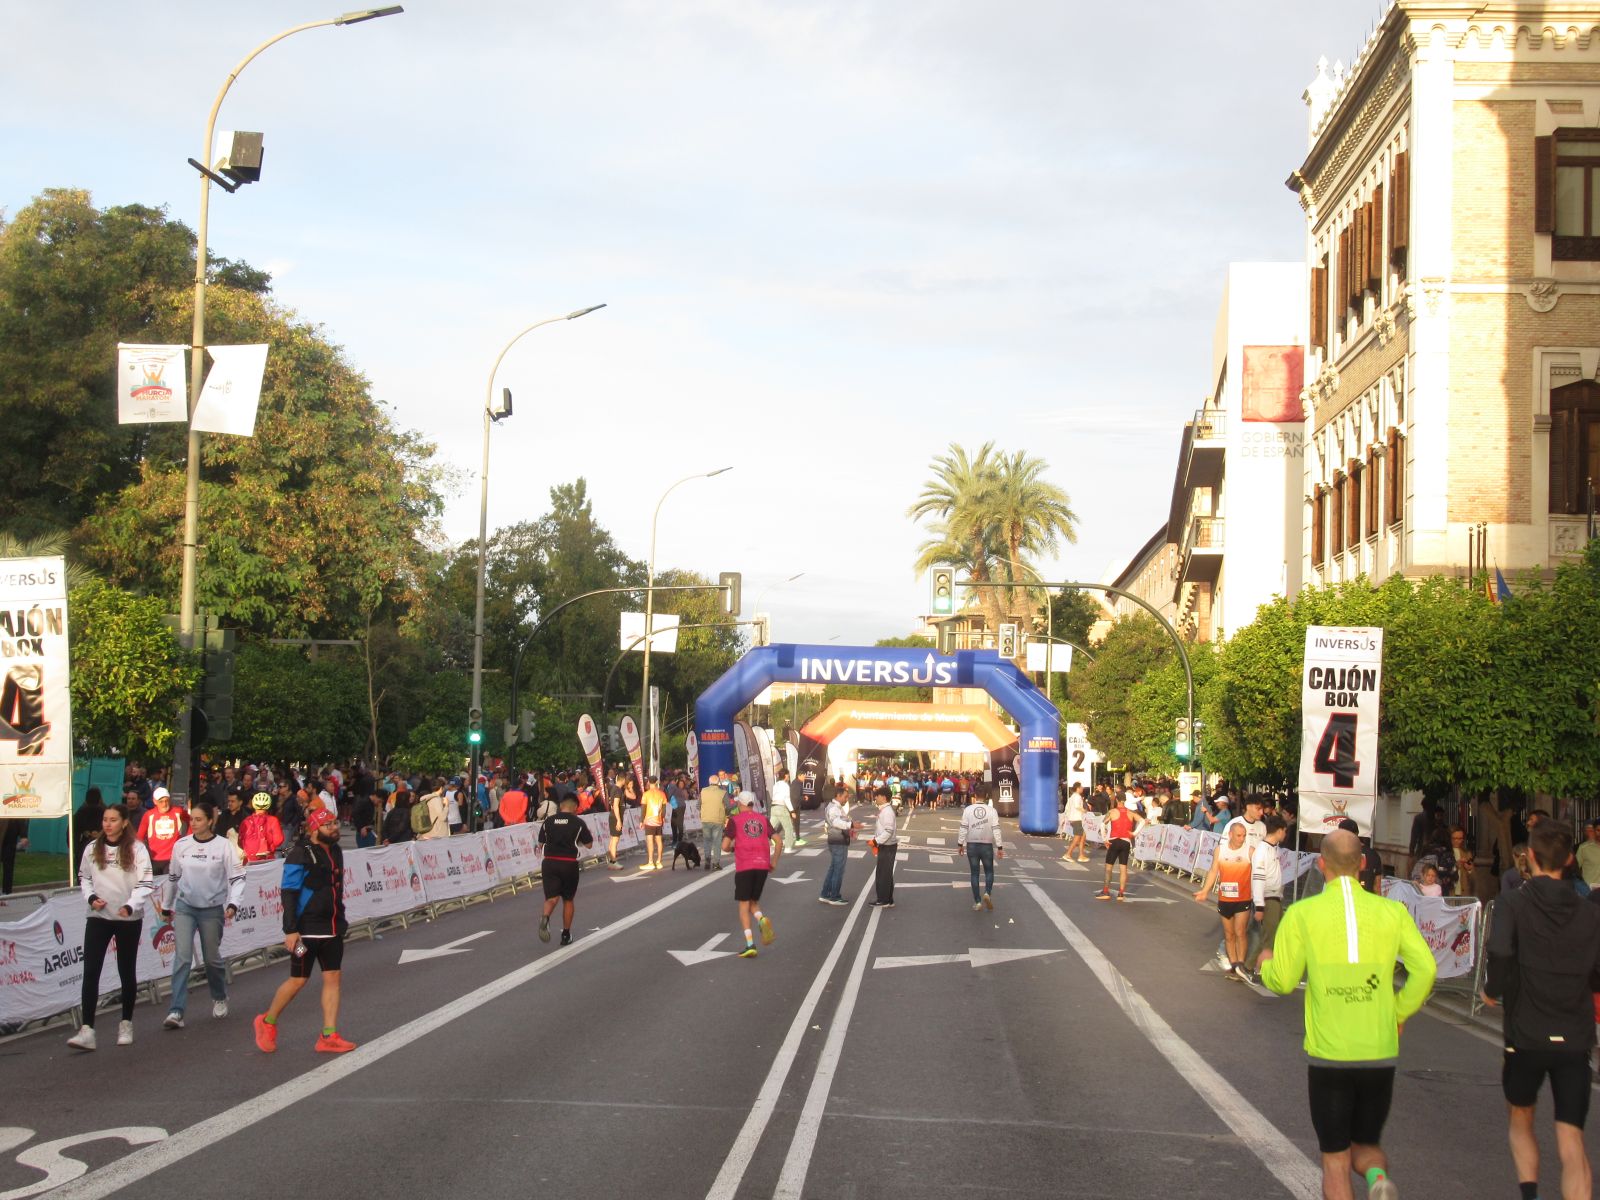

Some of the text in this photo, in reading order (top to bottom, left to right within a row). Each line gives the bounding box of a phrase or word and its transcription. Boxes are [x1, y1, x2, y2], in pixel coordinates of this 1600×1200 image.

[1242, 431, 1303, 443] GOBIERN
[1241, 444, 1304, 458] DE ESPAÑ
[1, 638, 44, 657] BOX
[1315, 636, 1376, 650] INVERSUS
[801, 652, 957, 684] INVERSUS
[1308, 665, 1376, 691] CAJÓN
[1325, 691, 1358, 707] BOX
[0, 663, 51, 756] 4
[850, 710, 919, 720] Ayuntamiento
[701, 732, 729, 741] MANERA
[1029, 740, 1056, 749] MANERA
[1314, 712, 1360, 788] 4
[1072, 750, 1085, 772] 2
[44, 945, 84, 974] ARGIUS
[1345, 994, 1373, 1004] plus
